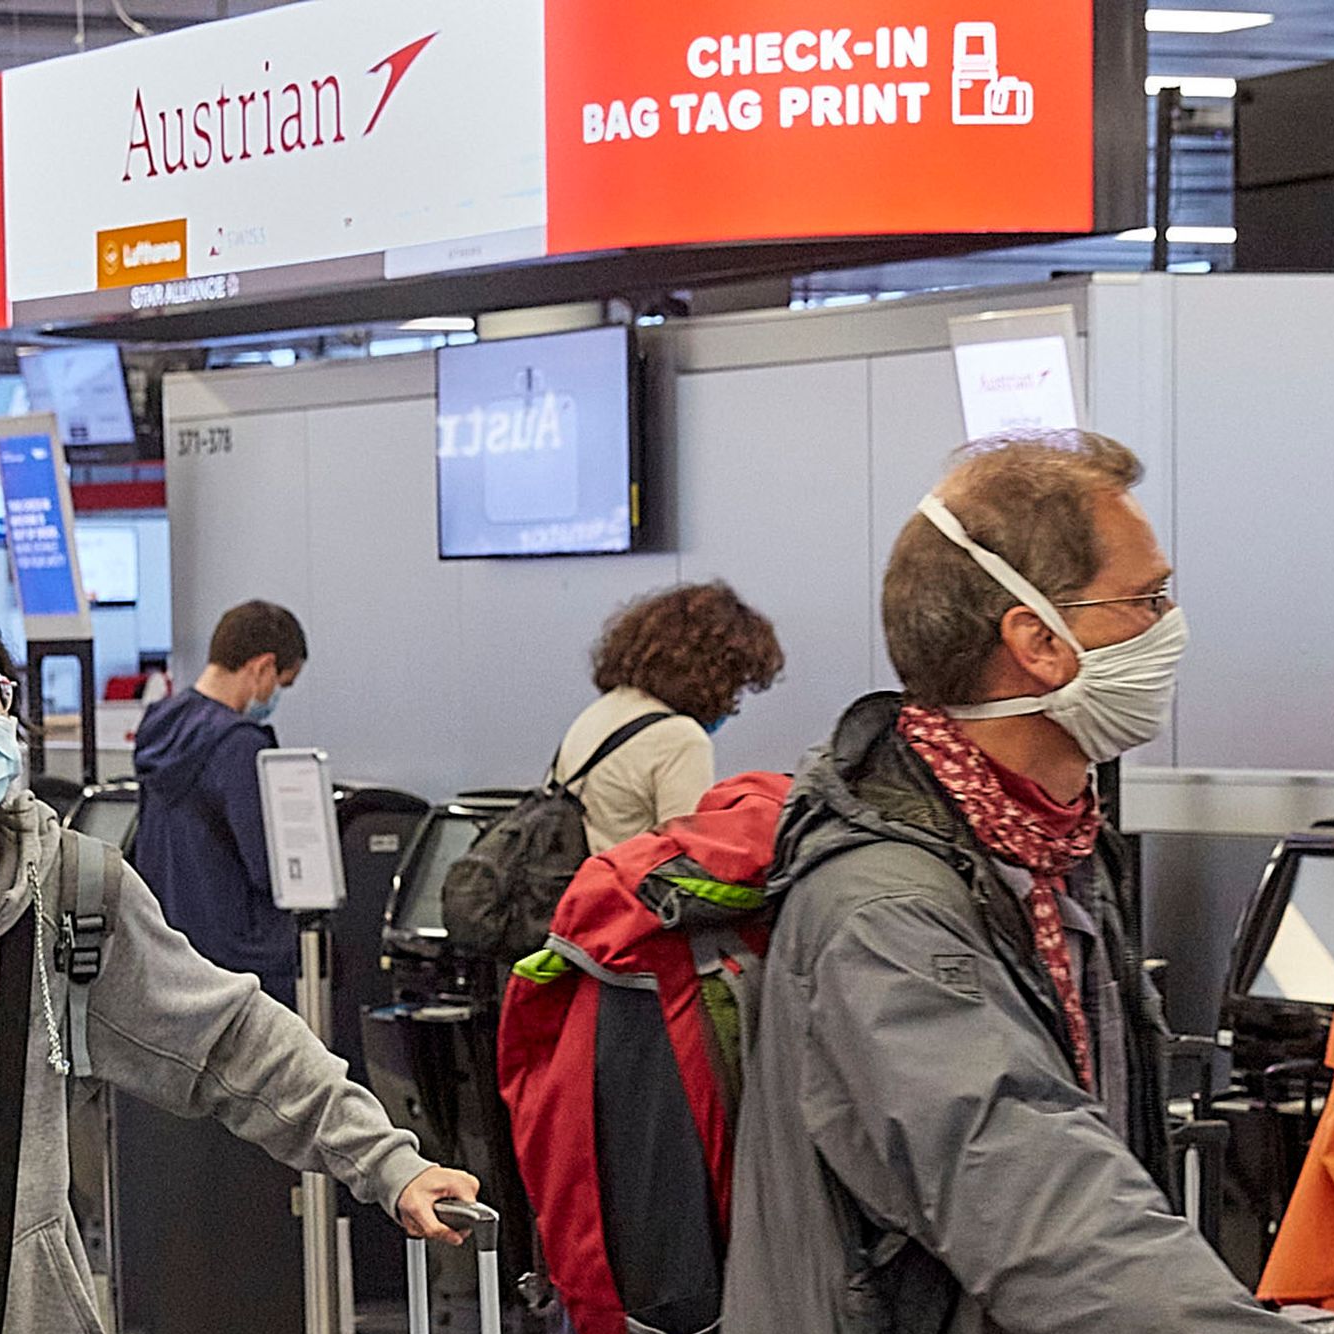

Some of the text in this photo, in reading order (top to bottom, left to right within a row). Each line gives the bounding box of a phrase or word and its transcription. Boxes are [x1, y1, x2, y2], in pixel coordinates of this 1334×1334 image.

[686, 26, 928, 79] CHECK-IN
[121, 60, 346, 183] Austrian
[582, 81, 931, 144] BAG TAG PRINT
